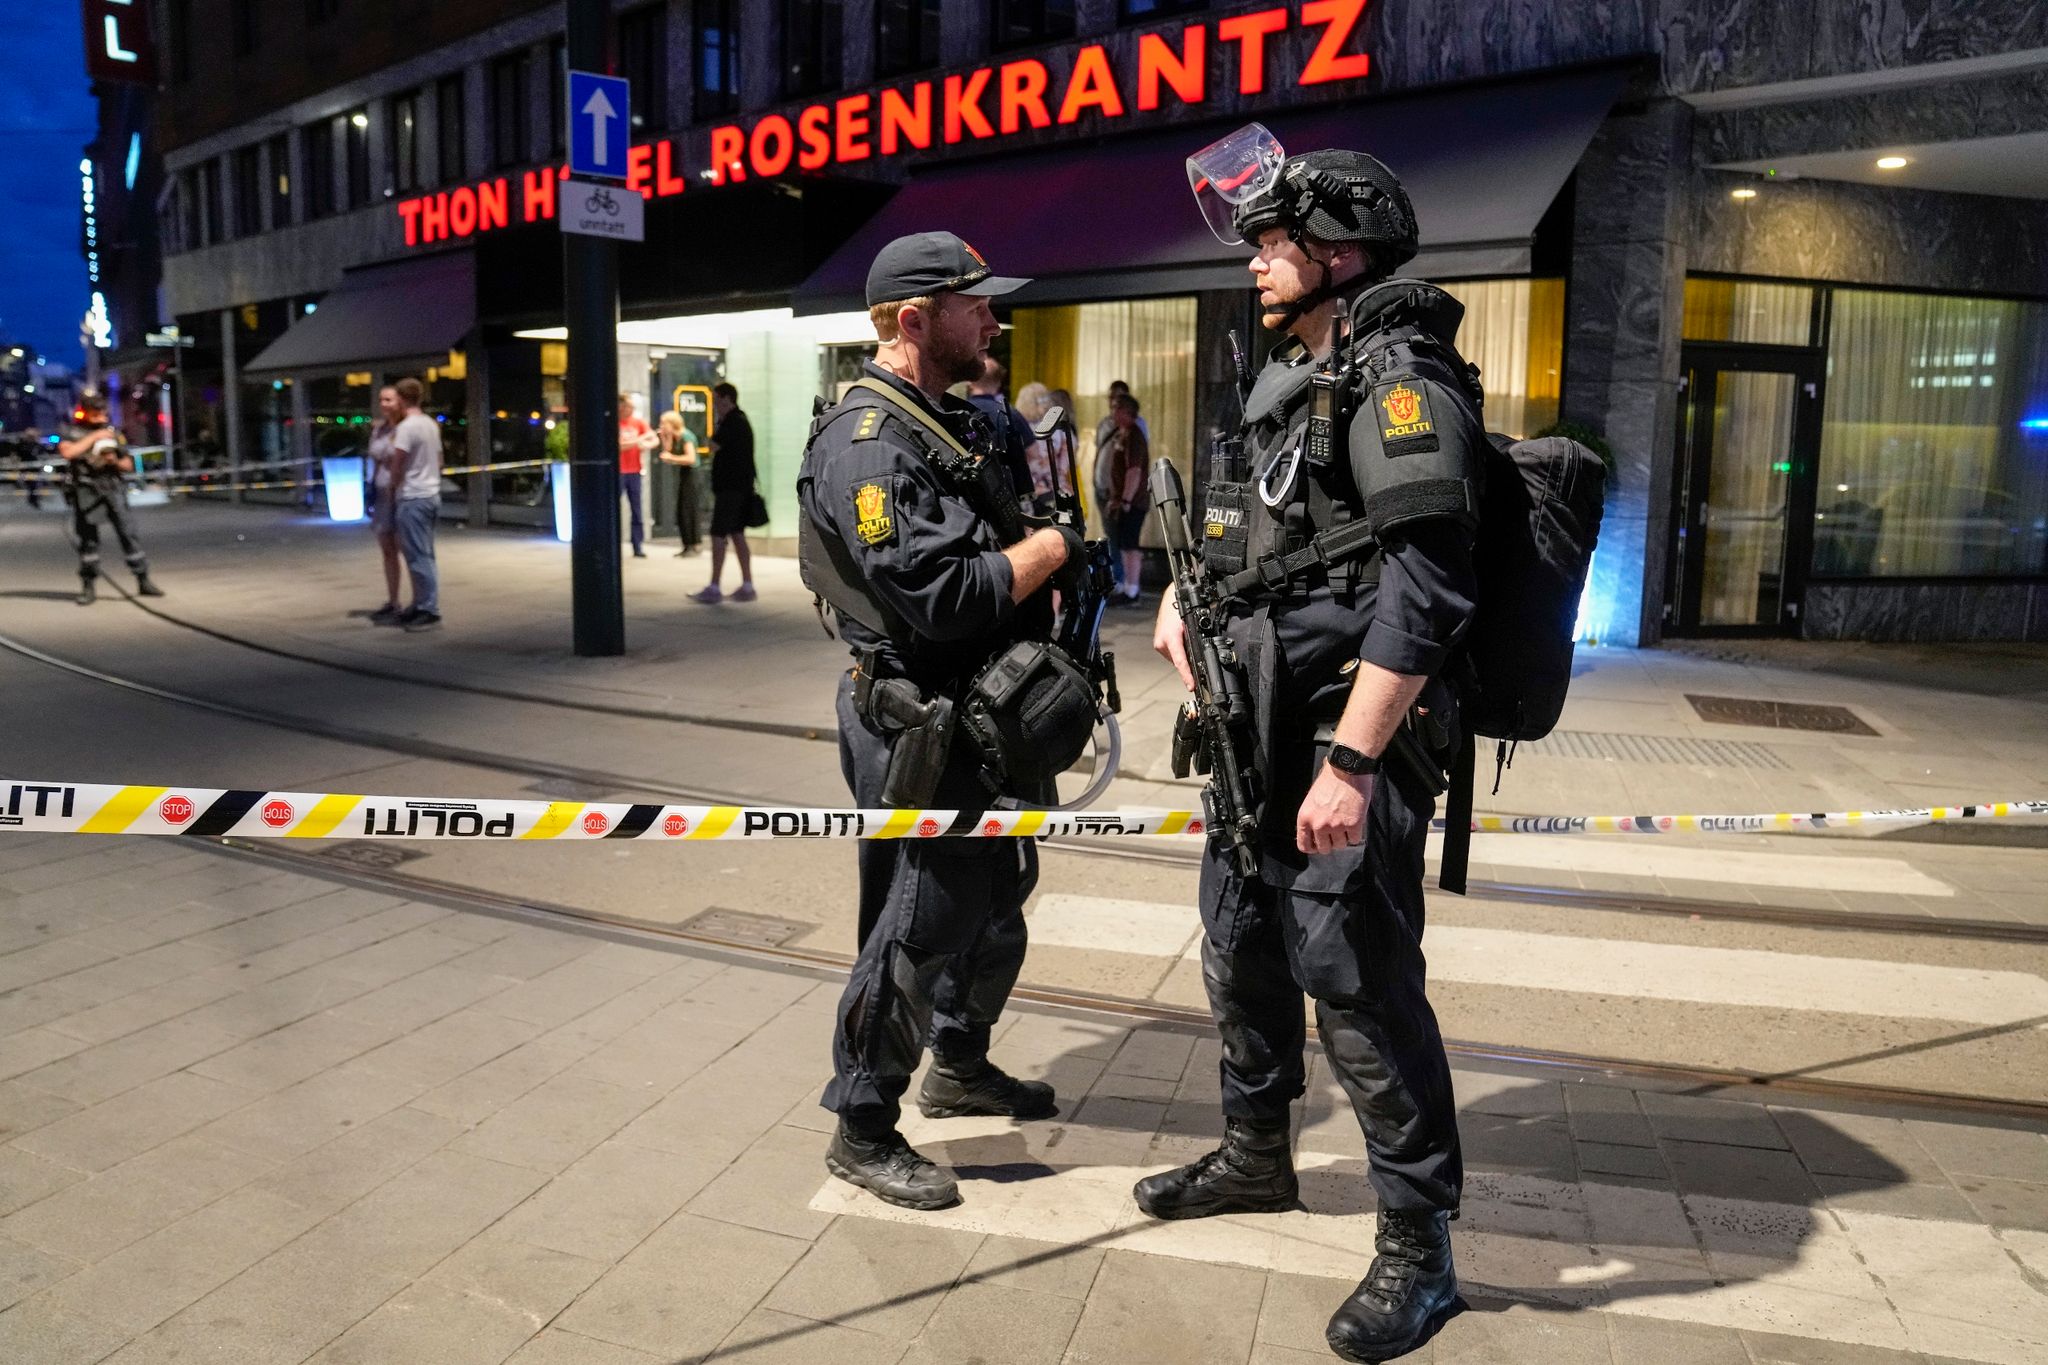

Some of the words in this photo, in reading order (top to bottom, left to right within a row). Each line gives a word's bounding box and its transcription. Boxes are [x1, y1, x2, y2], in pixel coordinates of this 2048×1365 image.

[103, 0, 138, 62] L
[399, 179, 508, 247] THON
[524, 140, 685, 222] HEL
[711, 0, 1370, 187] ROSENKRANTZ
[1384, 421, 1431, 438] POLITI
[1205, 507, 1241, 526] POLITI
[857, 517, 891, 535] POLITI
[0, 785, 75, 817] ITI
[163, 803, 191, 816] STOP
[264, 807, 291, 820] STOP
[364, 807, 515, 838] POLITI
[584, 818, 607, 830] STOP
[665, 819, 687, 831] STOP
[744, 811, 865, 837] POLITI
[919, 824, 938, 834] STOP
